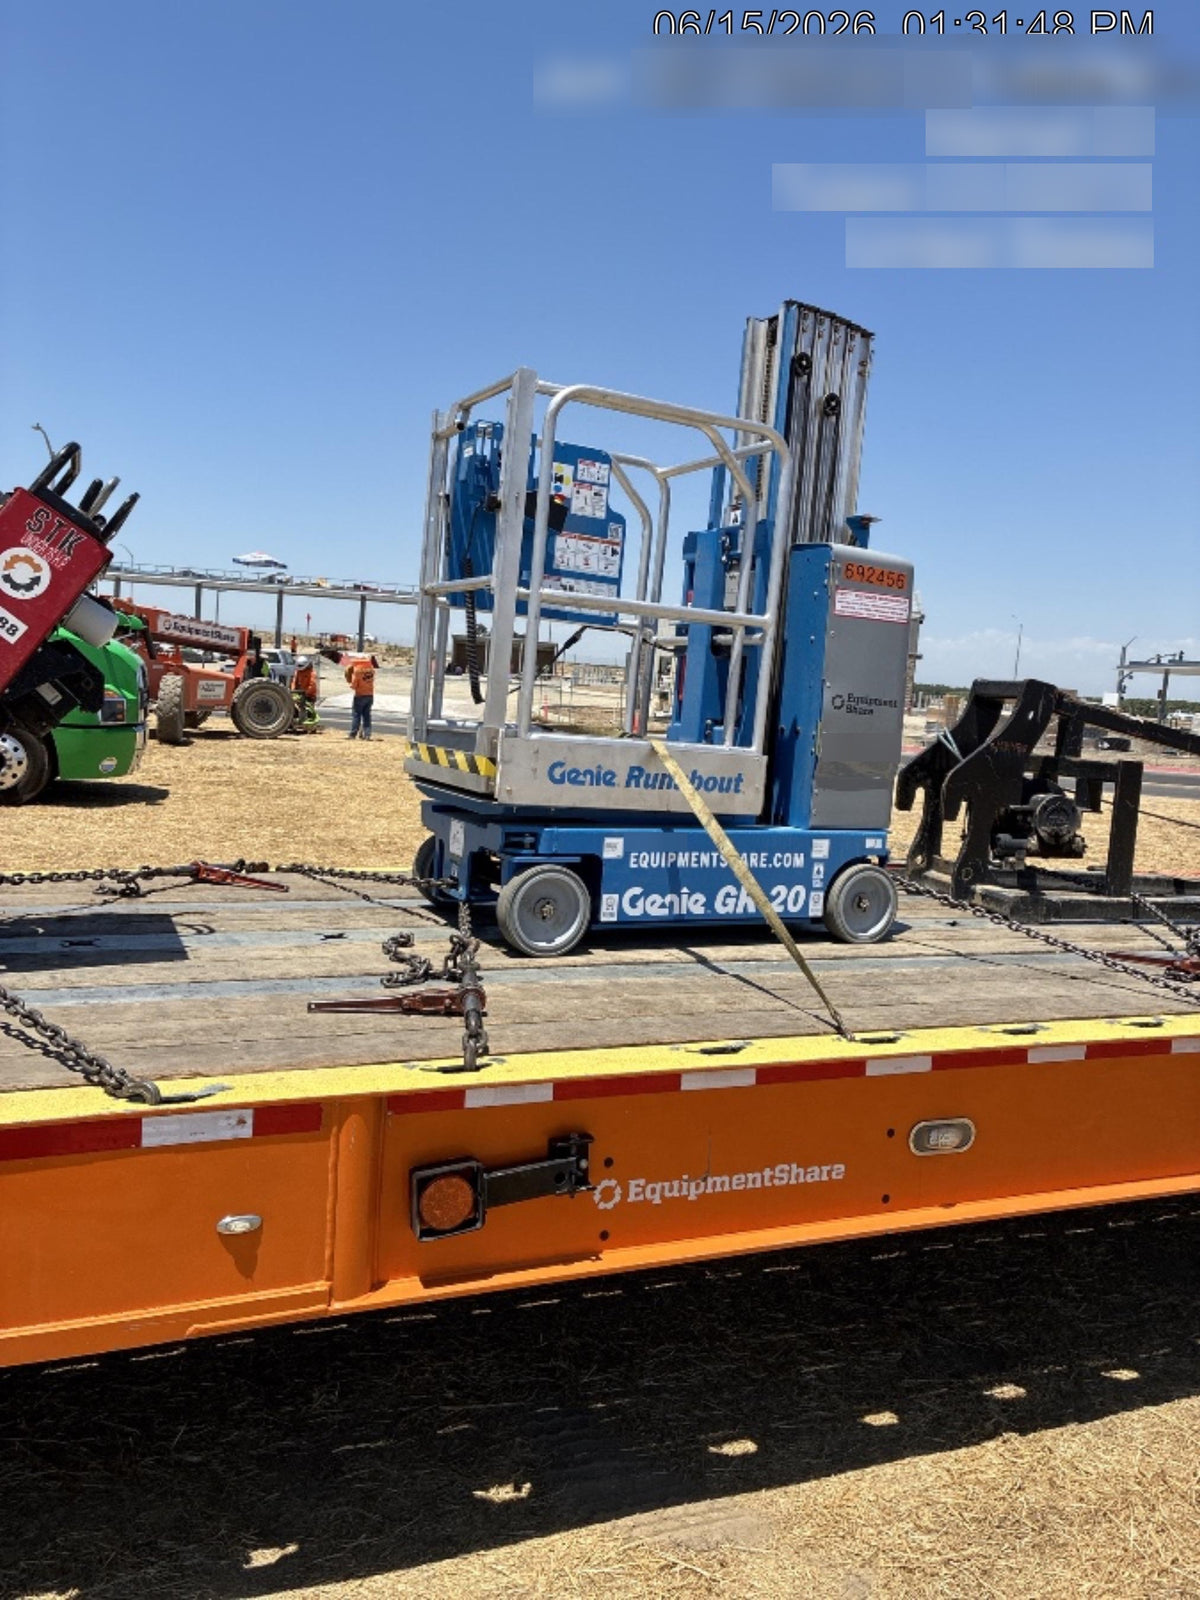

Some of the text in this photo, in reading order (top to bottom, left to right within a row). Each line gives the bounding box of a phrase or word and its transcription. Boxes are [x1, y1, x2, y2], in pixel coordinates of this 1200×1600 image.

[845, 562, 906, 590] 692456
[547, 760, 744, 794] Genie Runbout
[629, 851, 805, 869] EQUIPMENTSARE.COM
[622, 886, 707, 917] Genie
[627, 1163, 845, 1204] EquipmentShare
